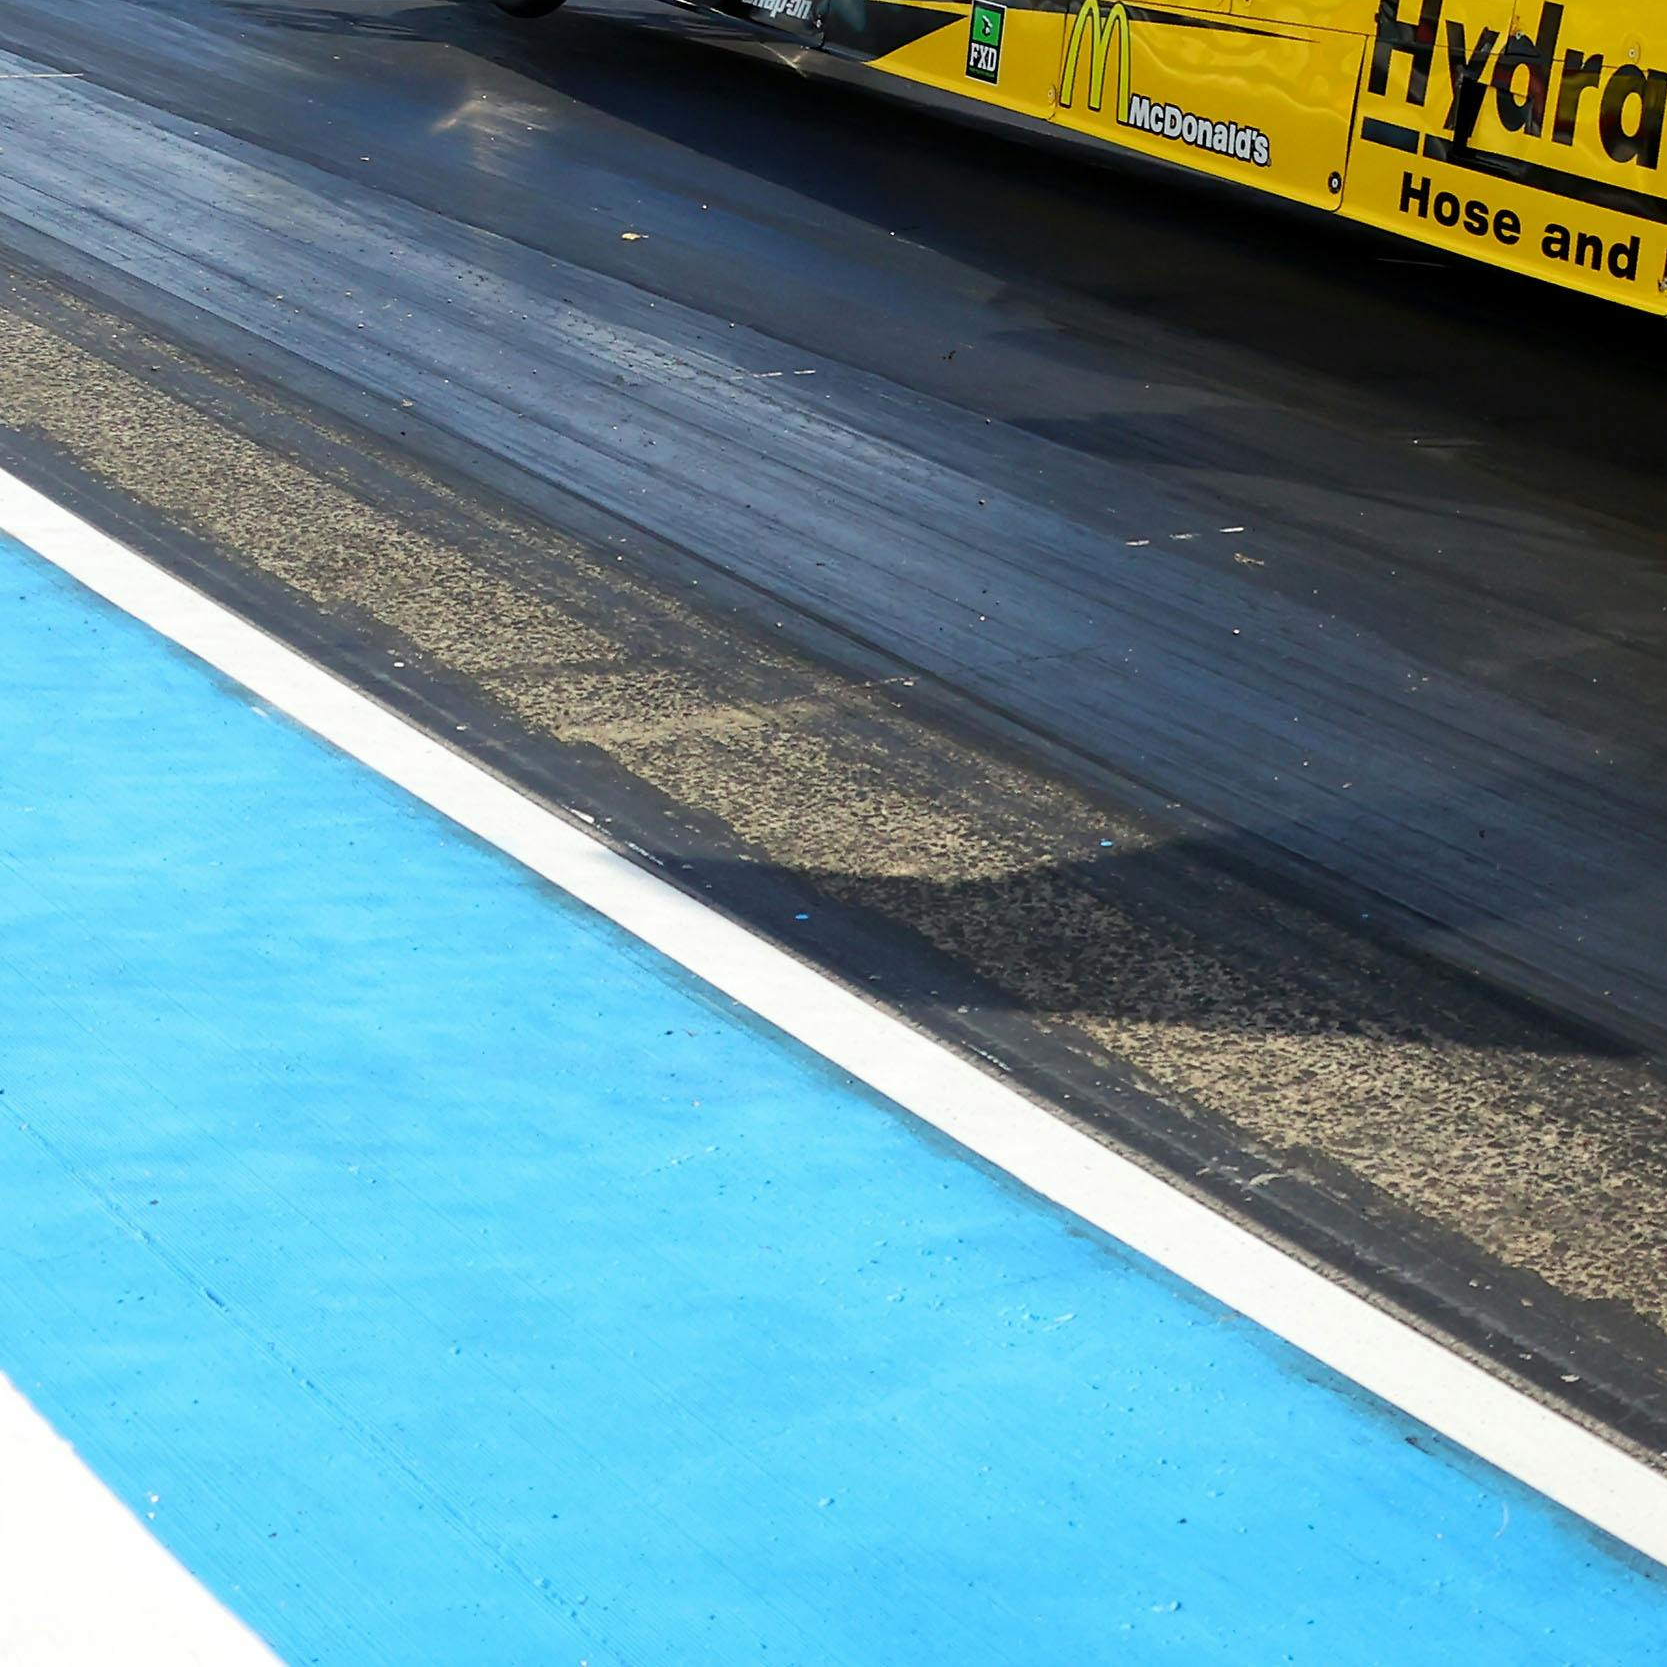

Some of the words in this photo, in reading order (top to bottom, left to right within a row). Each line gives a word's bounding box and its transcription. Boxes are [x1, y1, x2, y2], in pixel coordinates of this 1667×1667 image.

[969, 41, 998, 72] FXD
[1130, 95, 1270, 166] McDonald's
[1400, 171, 1522, 245] Hose
[1540, 221, 1640, 281] and
